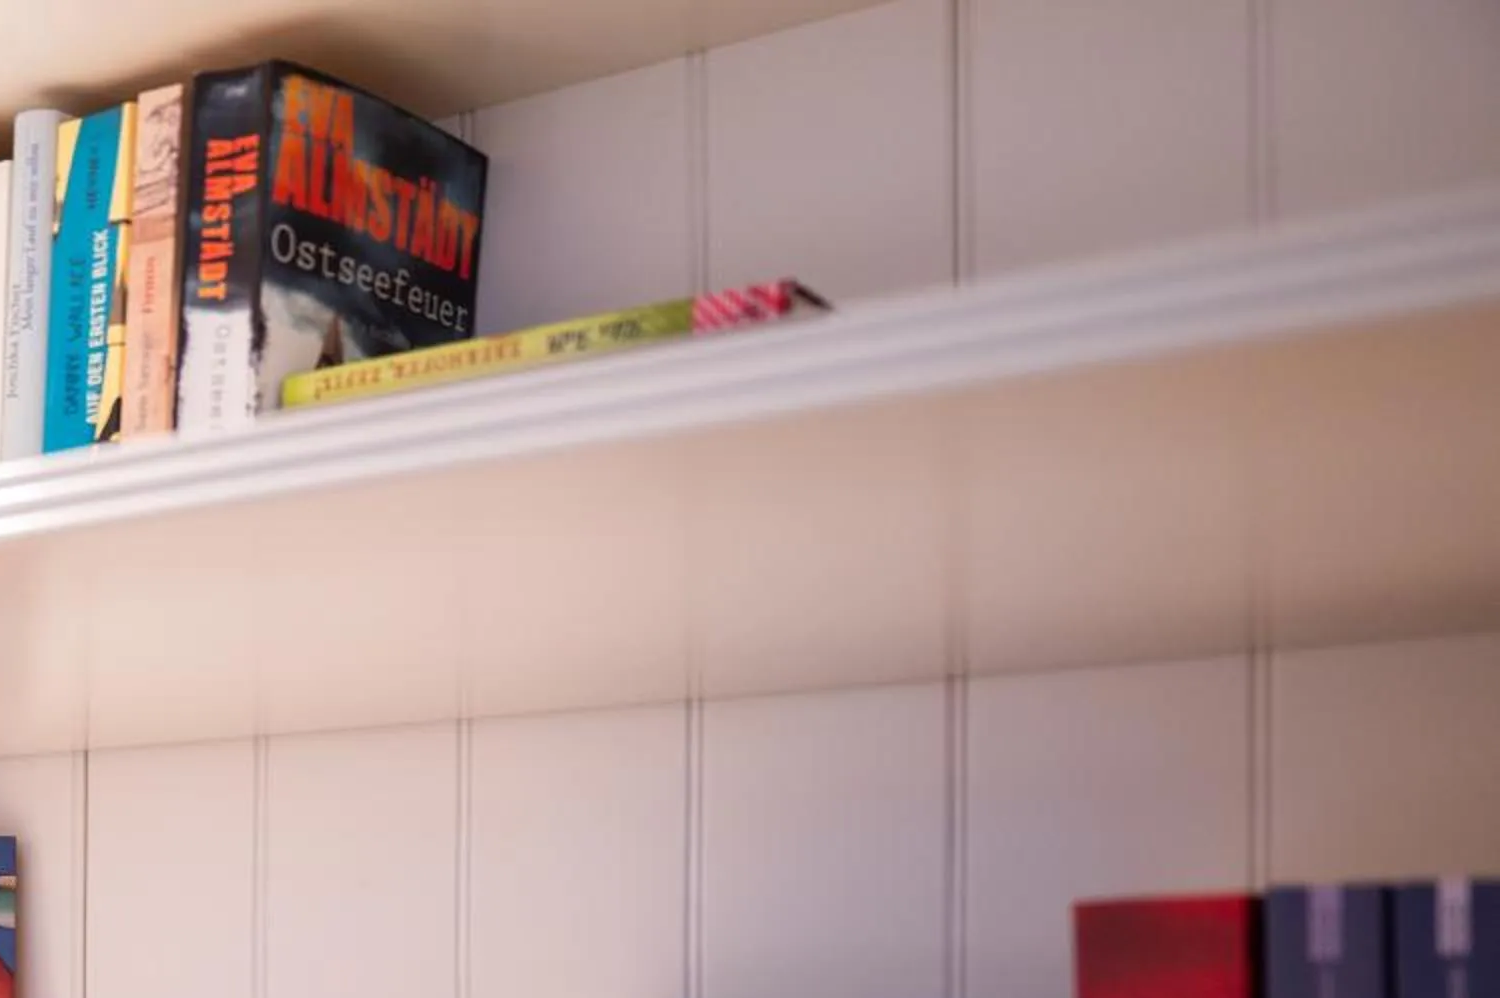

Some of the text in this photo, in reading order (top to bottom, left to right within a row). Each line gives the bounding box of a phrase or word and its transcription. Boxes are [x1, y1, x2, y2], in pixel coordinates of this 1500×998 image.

[283, 74, 356, 155] EVA
[231, 134, 260, 194] EVA
[272, 133, 480, 280] ALMSTÄDT
[89, 229, 109, 278] BLICK
[271, 224, 469, 333] Ostseefeuer
[88, 282, 107, 348] ERSTEN
[87, 352, 104, 387] DEN
[85, 392, 101, 425] AUF
